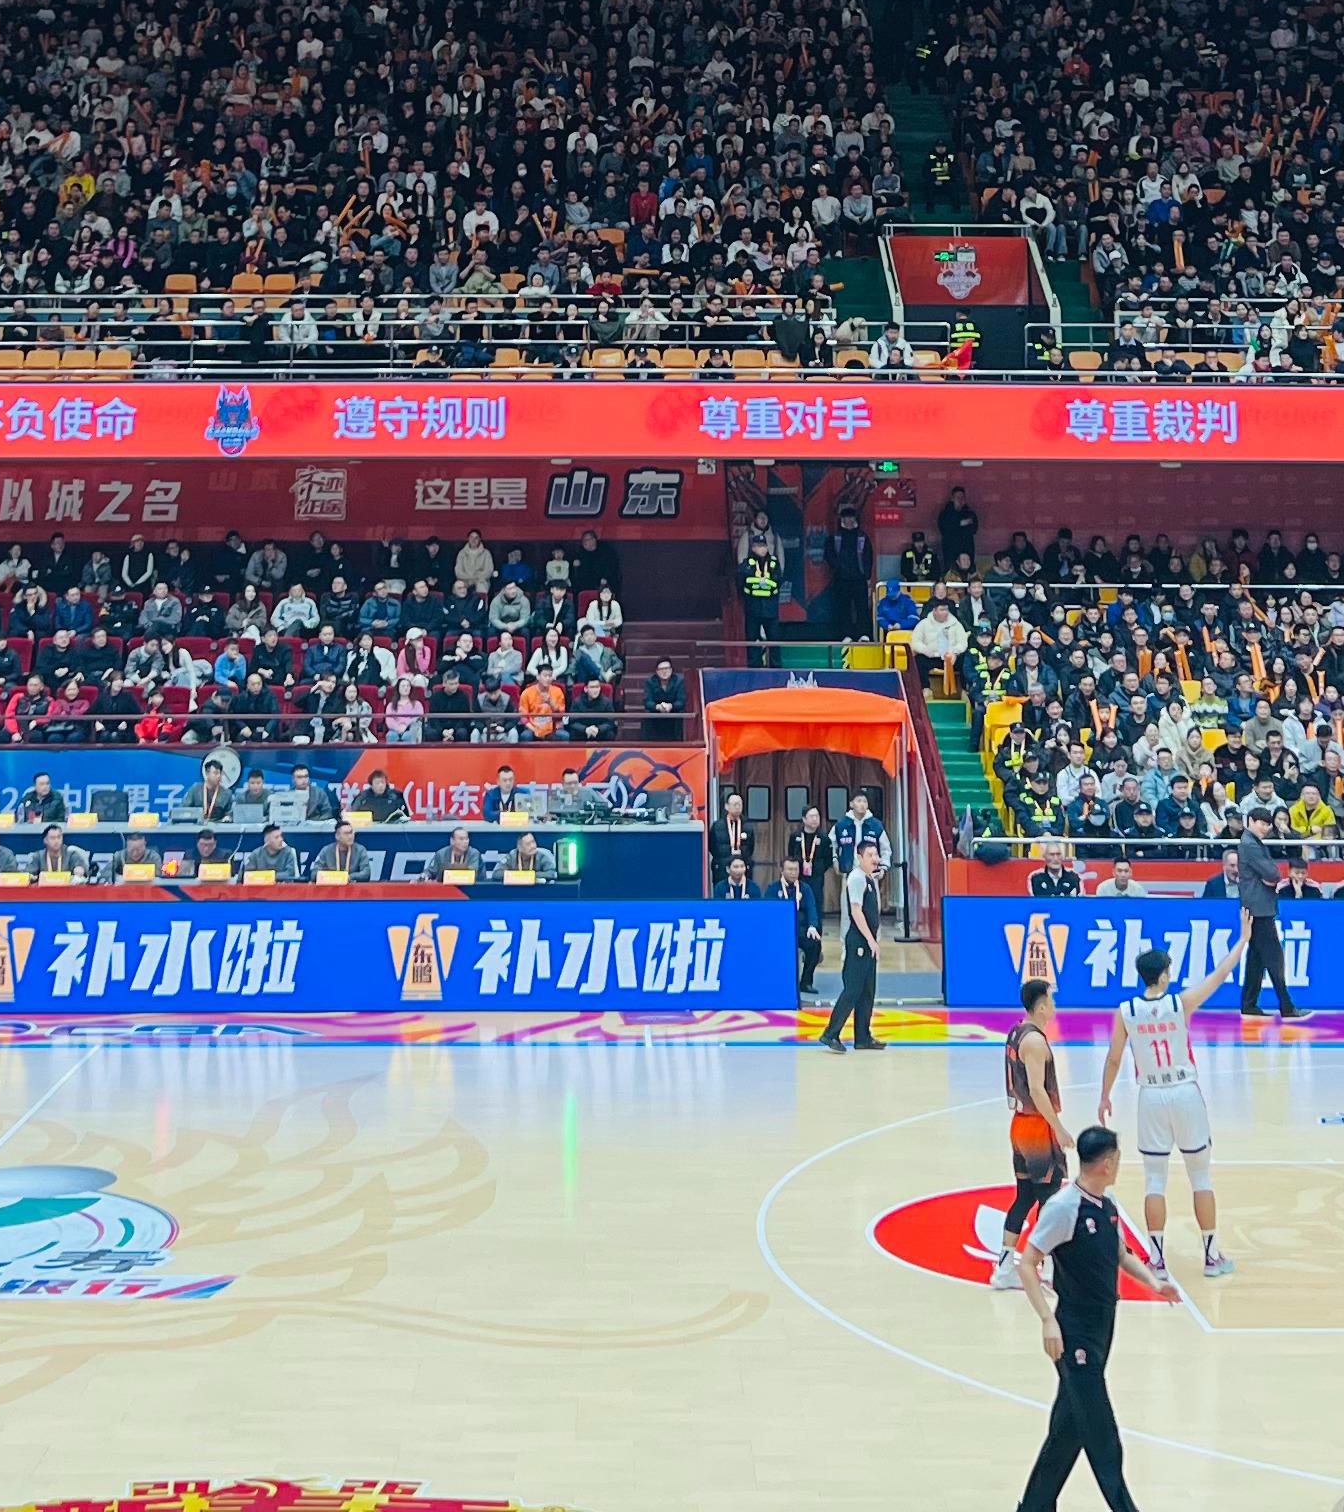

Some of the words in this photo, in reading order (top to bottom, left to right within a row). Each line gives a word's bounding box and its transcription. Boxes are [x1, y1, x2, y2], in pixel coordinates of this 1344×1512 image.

[333, 397, 506, 440] 遵守规则
[700, 397, 871, 441] 尊重对手
[1065, 399, 1238, 443] 尊重裁判
[0, 478, 182, 522] 以城之名
[414, 477, 528, 510] 这里是
[545, 467, 684, 519] 山东
[48, 920, 306, 996] 补水啦
[411, 942, 435, 986] 东鹏
[473, 918, 727, 994] 补水啦
[1026, 940, 1047, 978] 东鹏
[1150, 1039, 1172, 1067] 11
